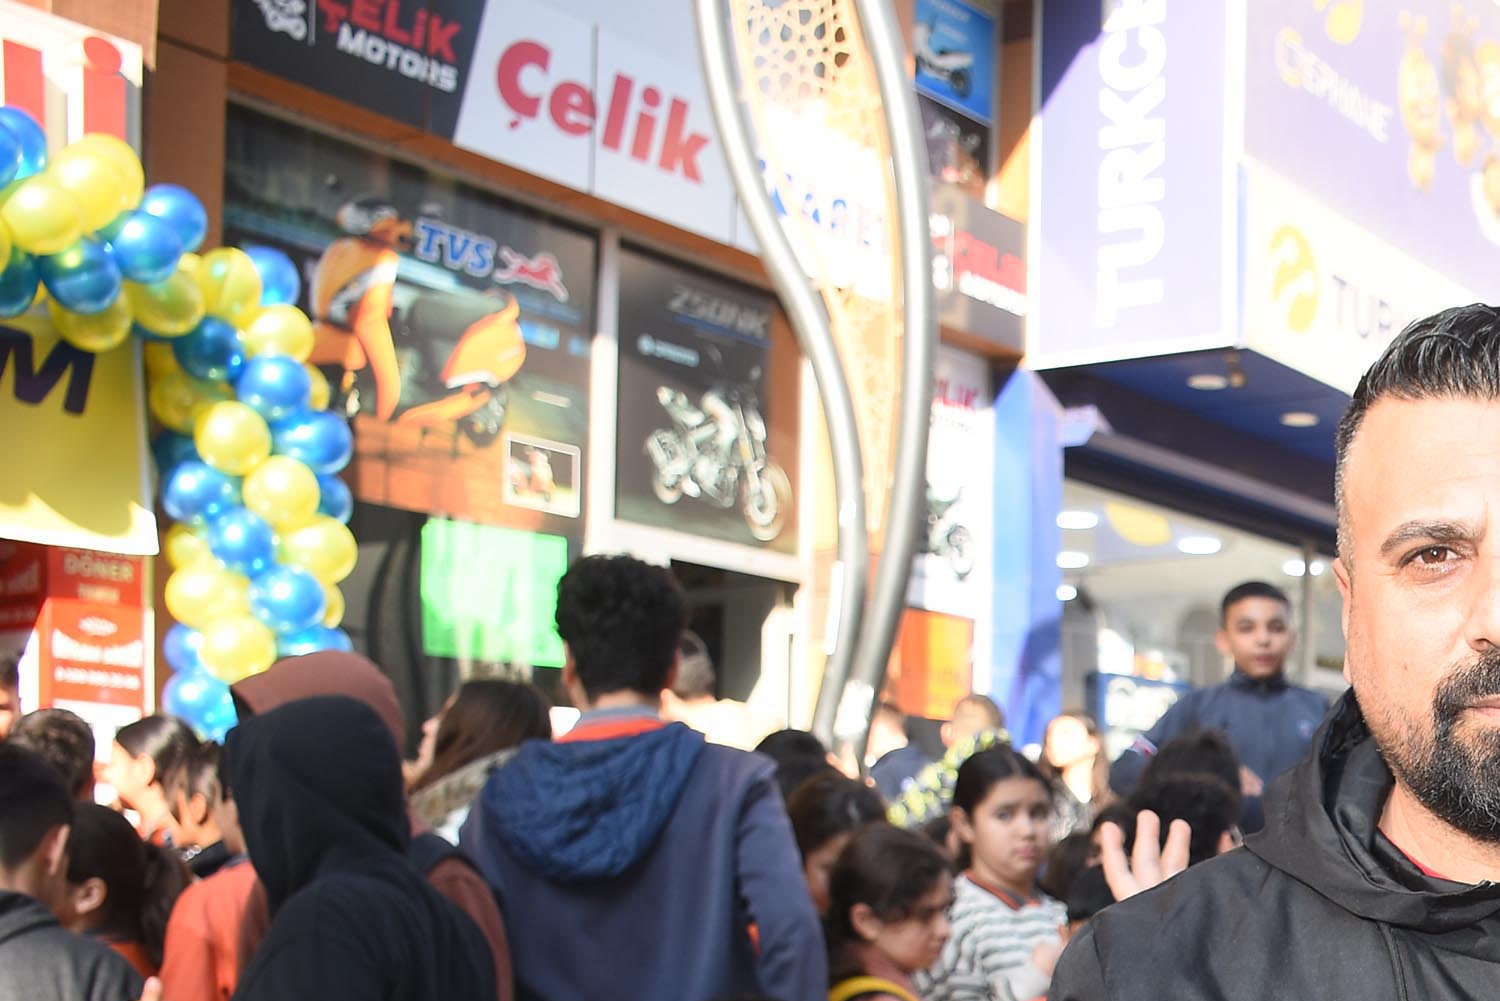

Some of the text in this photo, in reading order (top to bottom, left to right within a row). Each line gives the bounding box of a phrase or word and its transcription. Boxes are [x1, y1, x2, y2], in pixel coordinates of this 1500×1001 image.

[336, 22, 459, 93] MOTORS
[496, 38, 711, 186] Çelik
[416, 217, 496, 277] TVS
